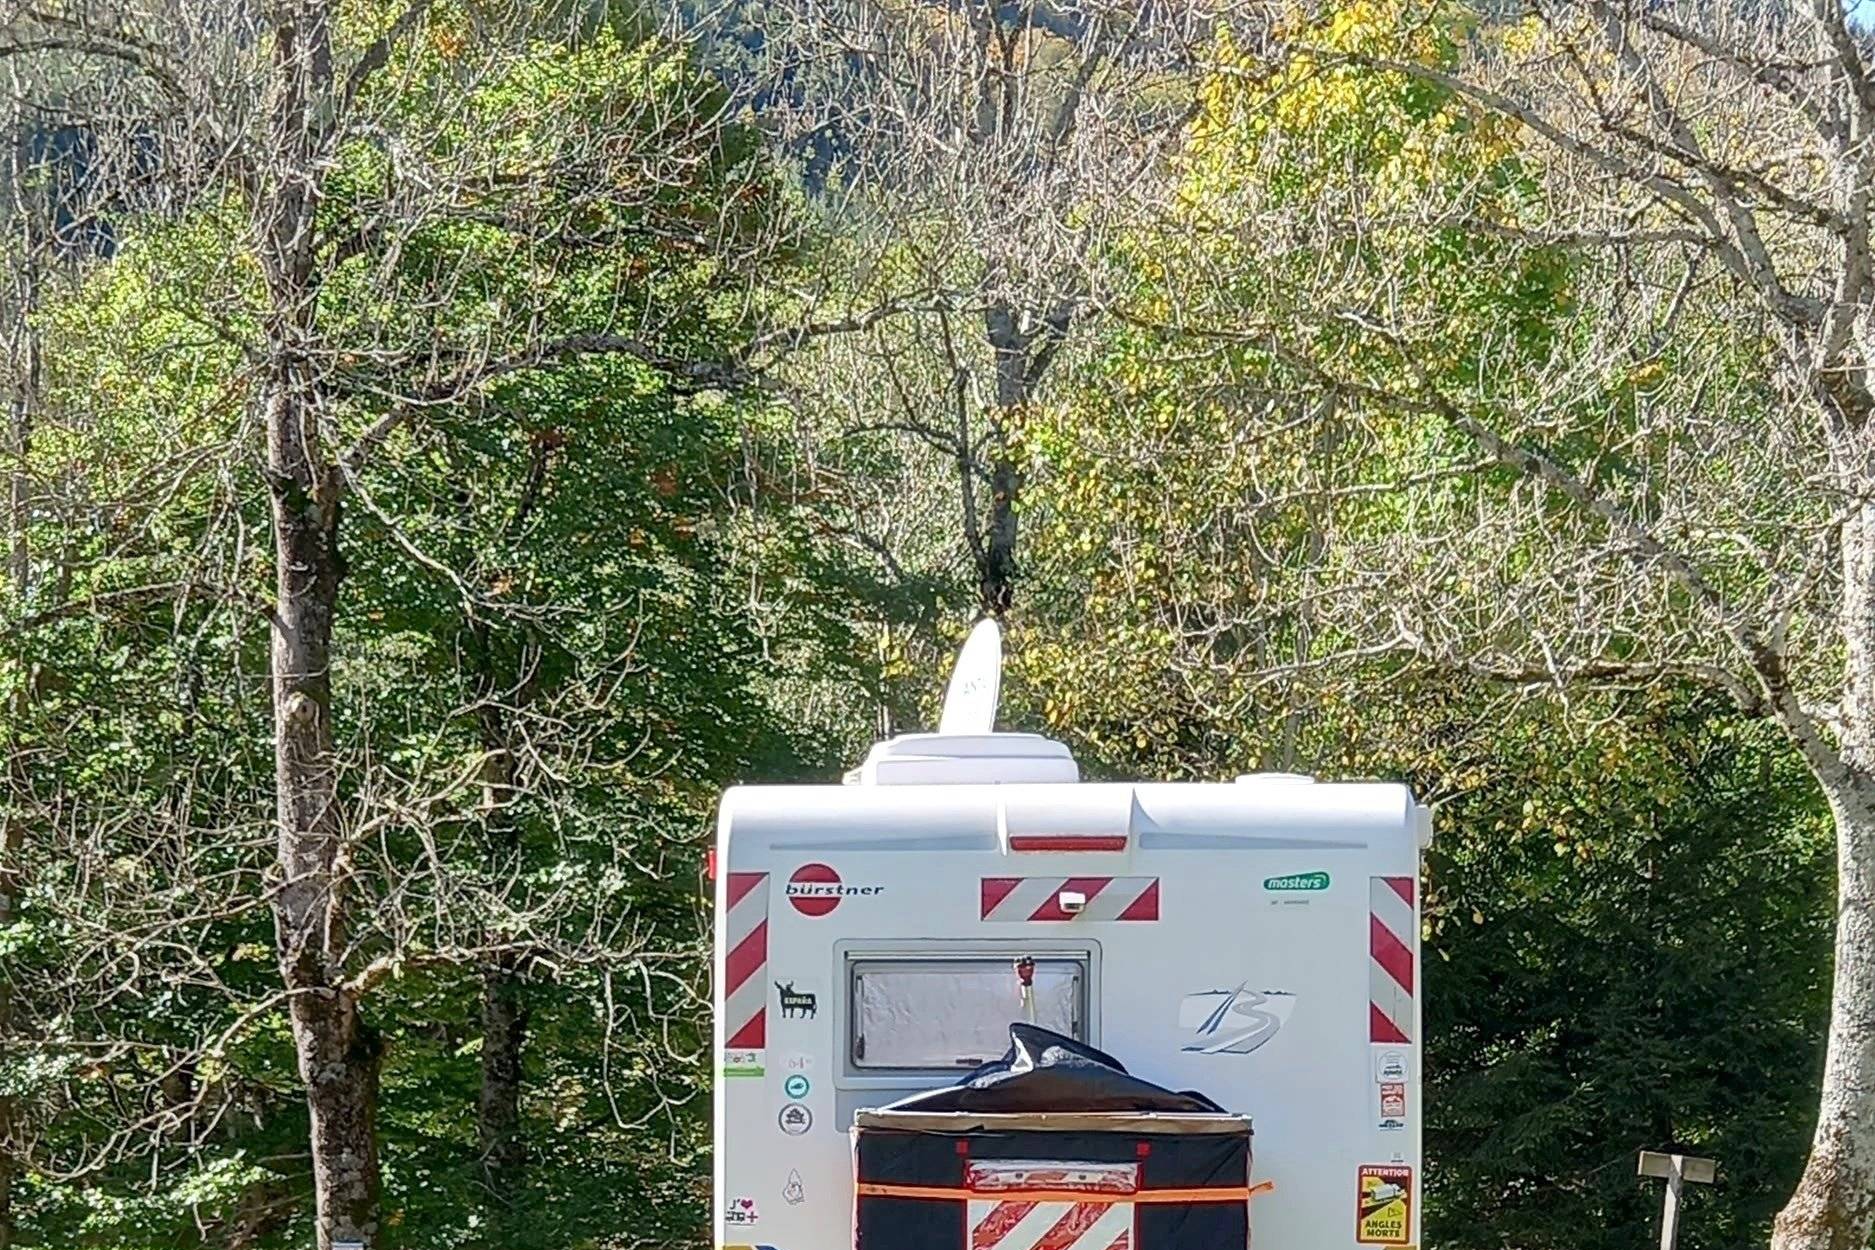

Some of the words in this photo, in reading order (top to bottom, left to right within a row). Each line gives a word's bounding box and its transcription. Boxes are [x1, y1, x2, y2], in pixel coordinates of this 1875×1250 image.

[1267, 876, 1322, 889] masters
[785, 883, 885, 896] bürstner
[1365, 1220, 1402, 1230] ANGLES
